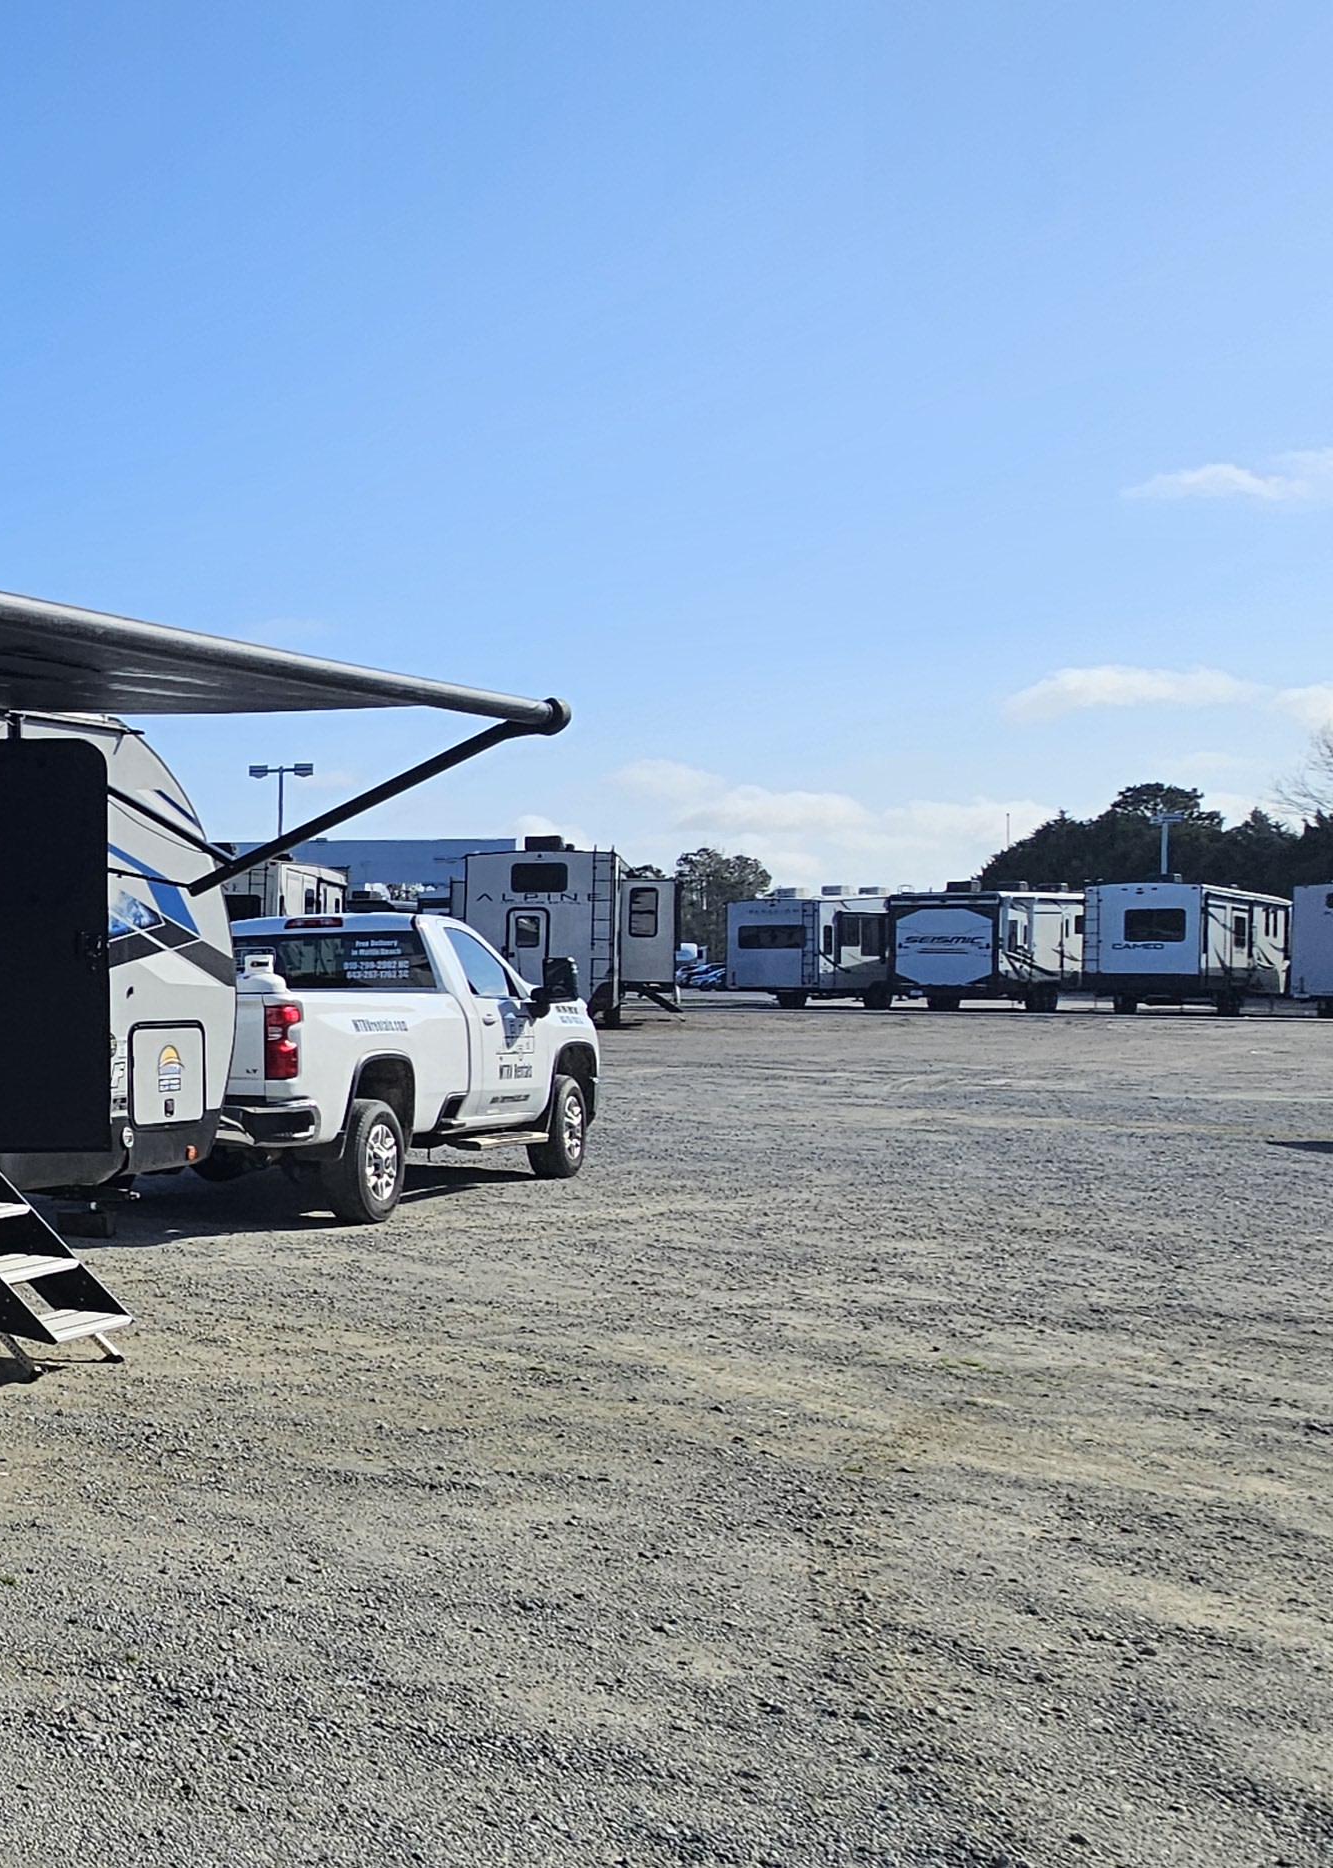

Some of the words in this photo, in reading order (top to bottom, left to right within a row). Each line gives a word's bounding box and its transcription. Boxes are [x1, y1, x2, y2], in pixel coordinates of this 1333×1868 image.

[475, 892, 603, 902] ALPINE
[903, 935, 986, 944] SEISMIC
[1111, 942, 1165, 950] CAMEO
[514, 1063, 533, 1079] Rentals
